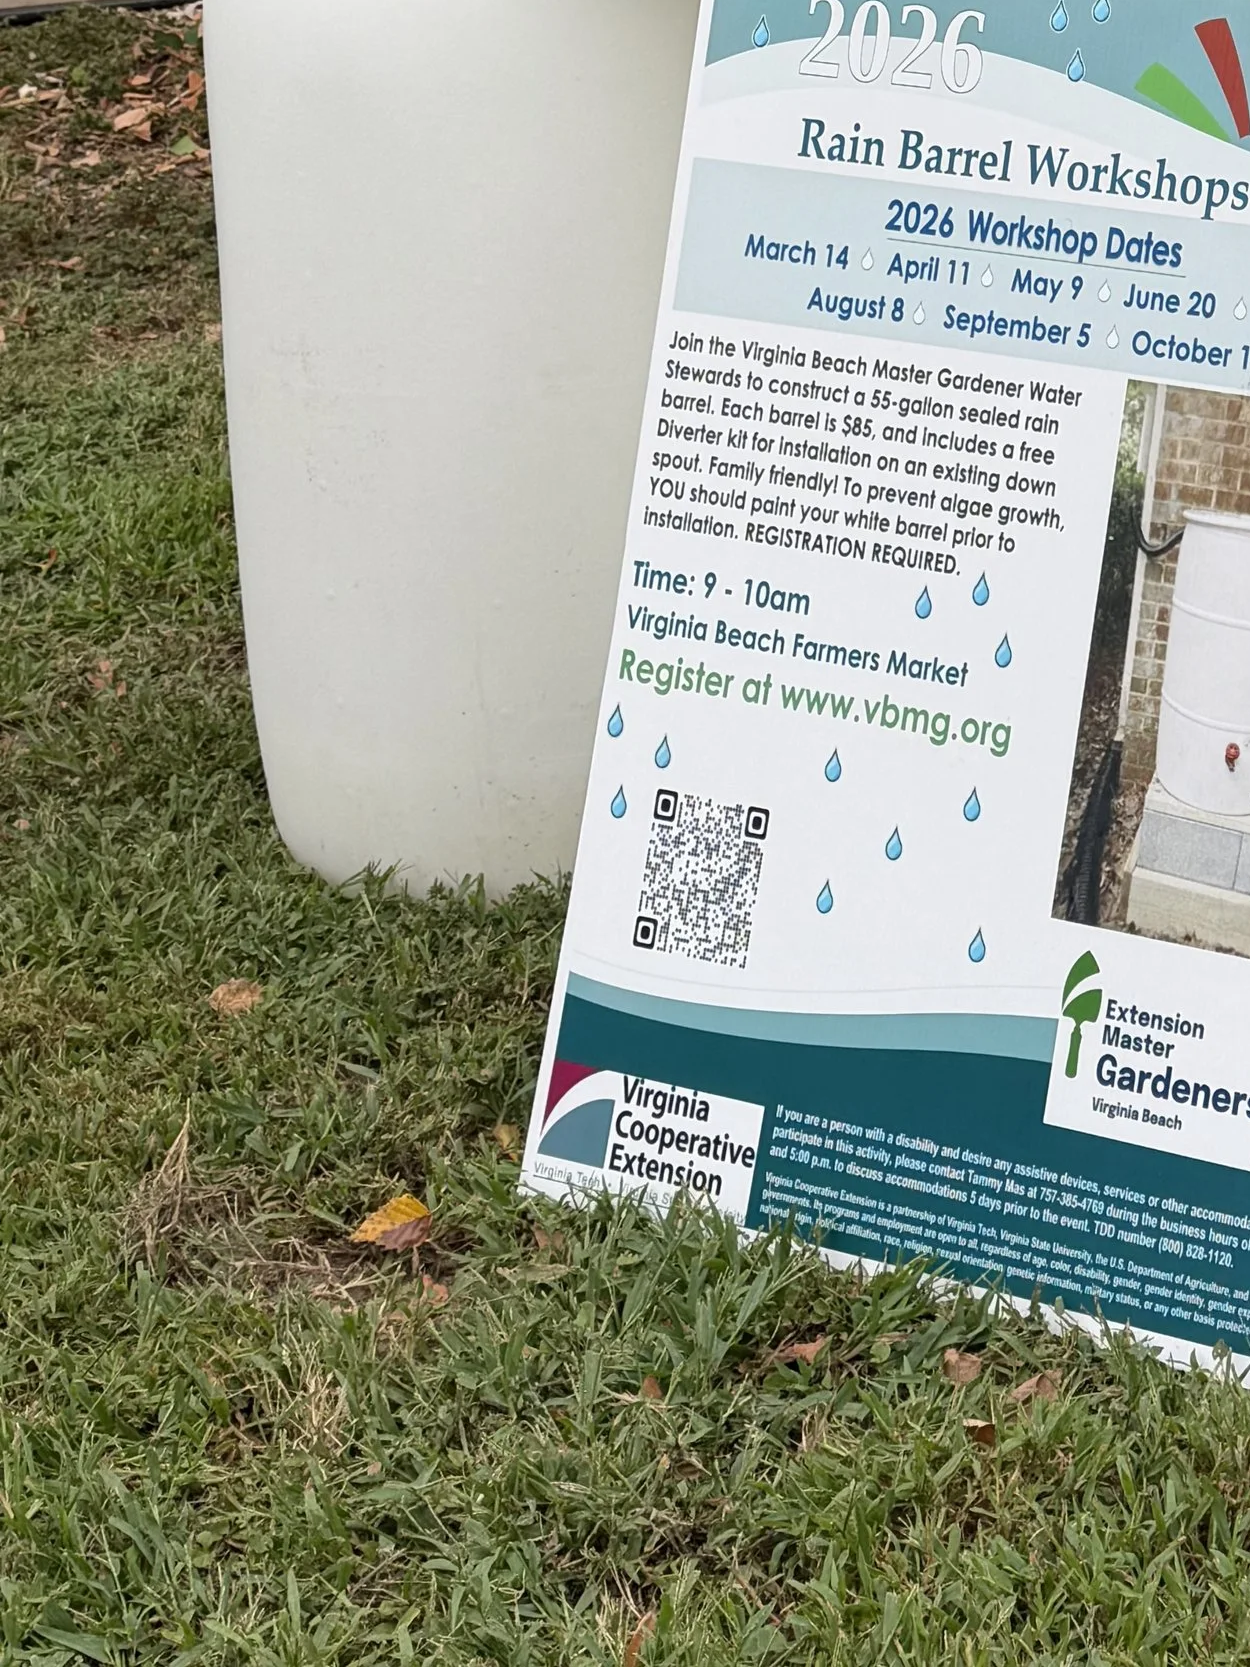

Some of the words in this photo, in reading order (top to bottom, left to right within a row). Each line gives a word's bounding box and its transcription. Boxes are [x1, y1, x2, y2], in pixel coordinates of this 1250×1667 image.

[797, 117, 885, 167] Rain
[897, 129, 1013, 182] Barrel
[1026, 144, 1249, 221] Workshops
[884, 199, 954, 239] 2026
[968, 209, 1098, 263] Workshop
[1105, 226, 1183, 268] Dates
[744, 233, 816, 266] March
[826, 243, 849, 270] 14
[886, 252, 940, 285] April
[948, 259, 970, 286] 11
[1010, 268, 1064, 304] May
[1071, 275, 1084, 301] 9
[1122, 283, 1181, 314] June
[1186, 291, 1217, 319] 20
[806, 286, 887, 321] August
[890, 297, 905, 323] 8
[943, 304, 1072, 345] September
[1076, 322, 1092, 348] 5
[1131, 330, 1233, 368] October
[668, 330, 704, 353] Join
[709, 335, 736, 358] the
[742, 340, 807, 368] Virginia
[811, 350, 867, 377] Beach
[871, 358, 933, 385] Master
[937, 367, 1025, 399] Gardener
[1030, 380, 1083, 407] Water
[633, 560, 695, 596] Time:
[704, 571, 717, 599] 9
[744, 578, 810, 616] 10am
[619, 648, 735, 699] Register
[742, 673, 773, 706] at
[780, 684, 1012, 758] www.vbmg.org
[1102, 1024, 1175, 1059] Master
[1105, 998, 1205, 1040] Extension
[1092, 1096, 1139, 1121] Virginia
[1141, 1108, 1183, 1131] Beach
[769, 1145, 789, 1159] and
[789, 1147, 811, 1164] 5:00
[810, 1155, 832, 1170] p.m.
[834, 1158, 845, 1173] to
[845, 1161, 884, 1182] discuss
[884, 1173, 968, 1203] accommodations
[969, 1190, 977, 1205] 5
[977, 1193, 1002, 1212] days
[1003, 1201, 1029, 1217] prior
[1029, 1205, 1041, 1220] to
[1042, 1208, 1059, 1225] the
[1060, 1215, 1090, 1233] event.
[1093, 1220, 1116, 1238] TDD
[1116, 1229, 1157, 1249] number
[1158, 1236, 1184, 1258] (800)
[1185, 1243, 1234, 1268] 828-1120.
